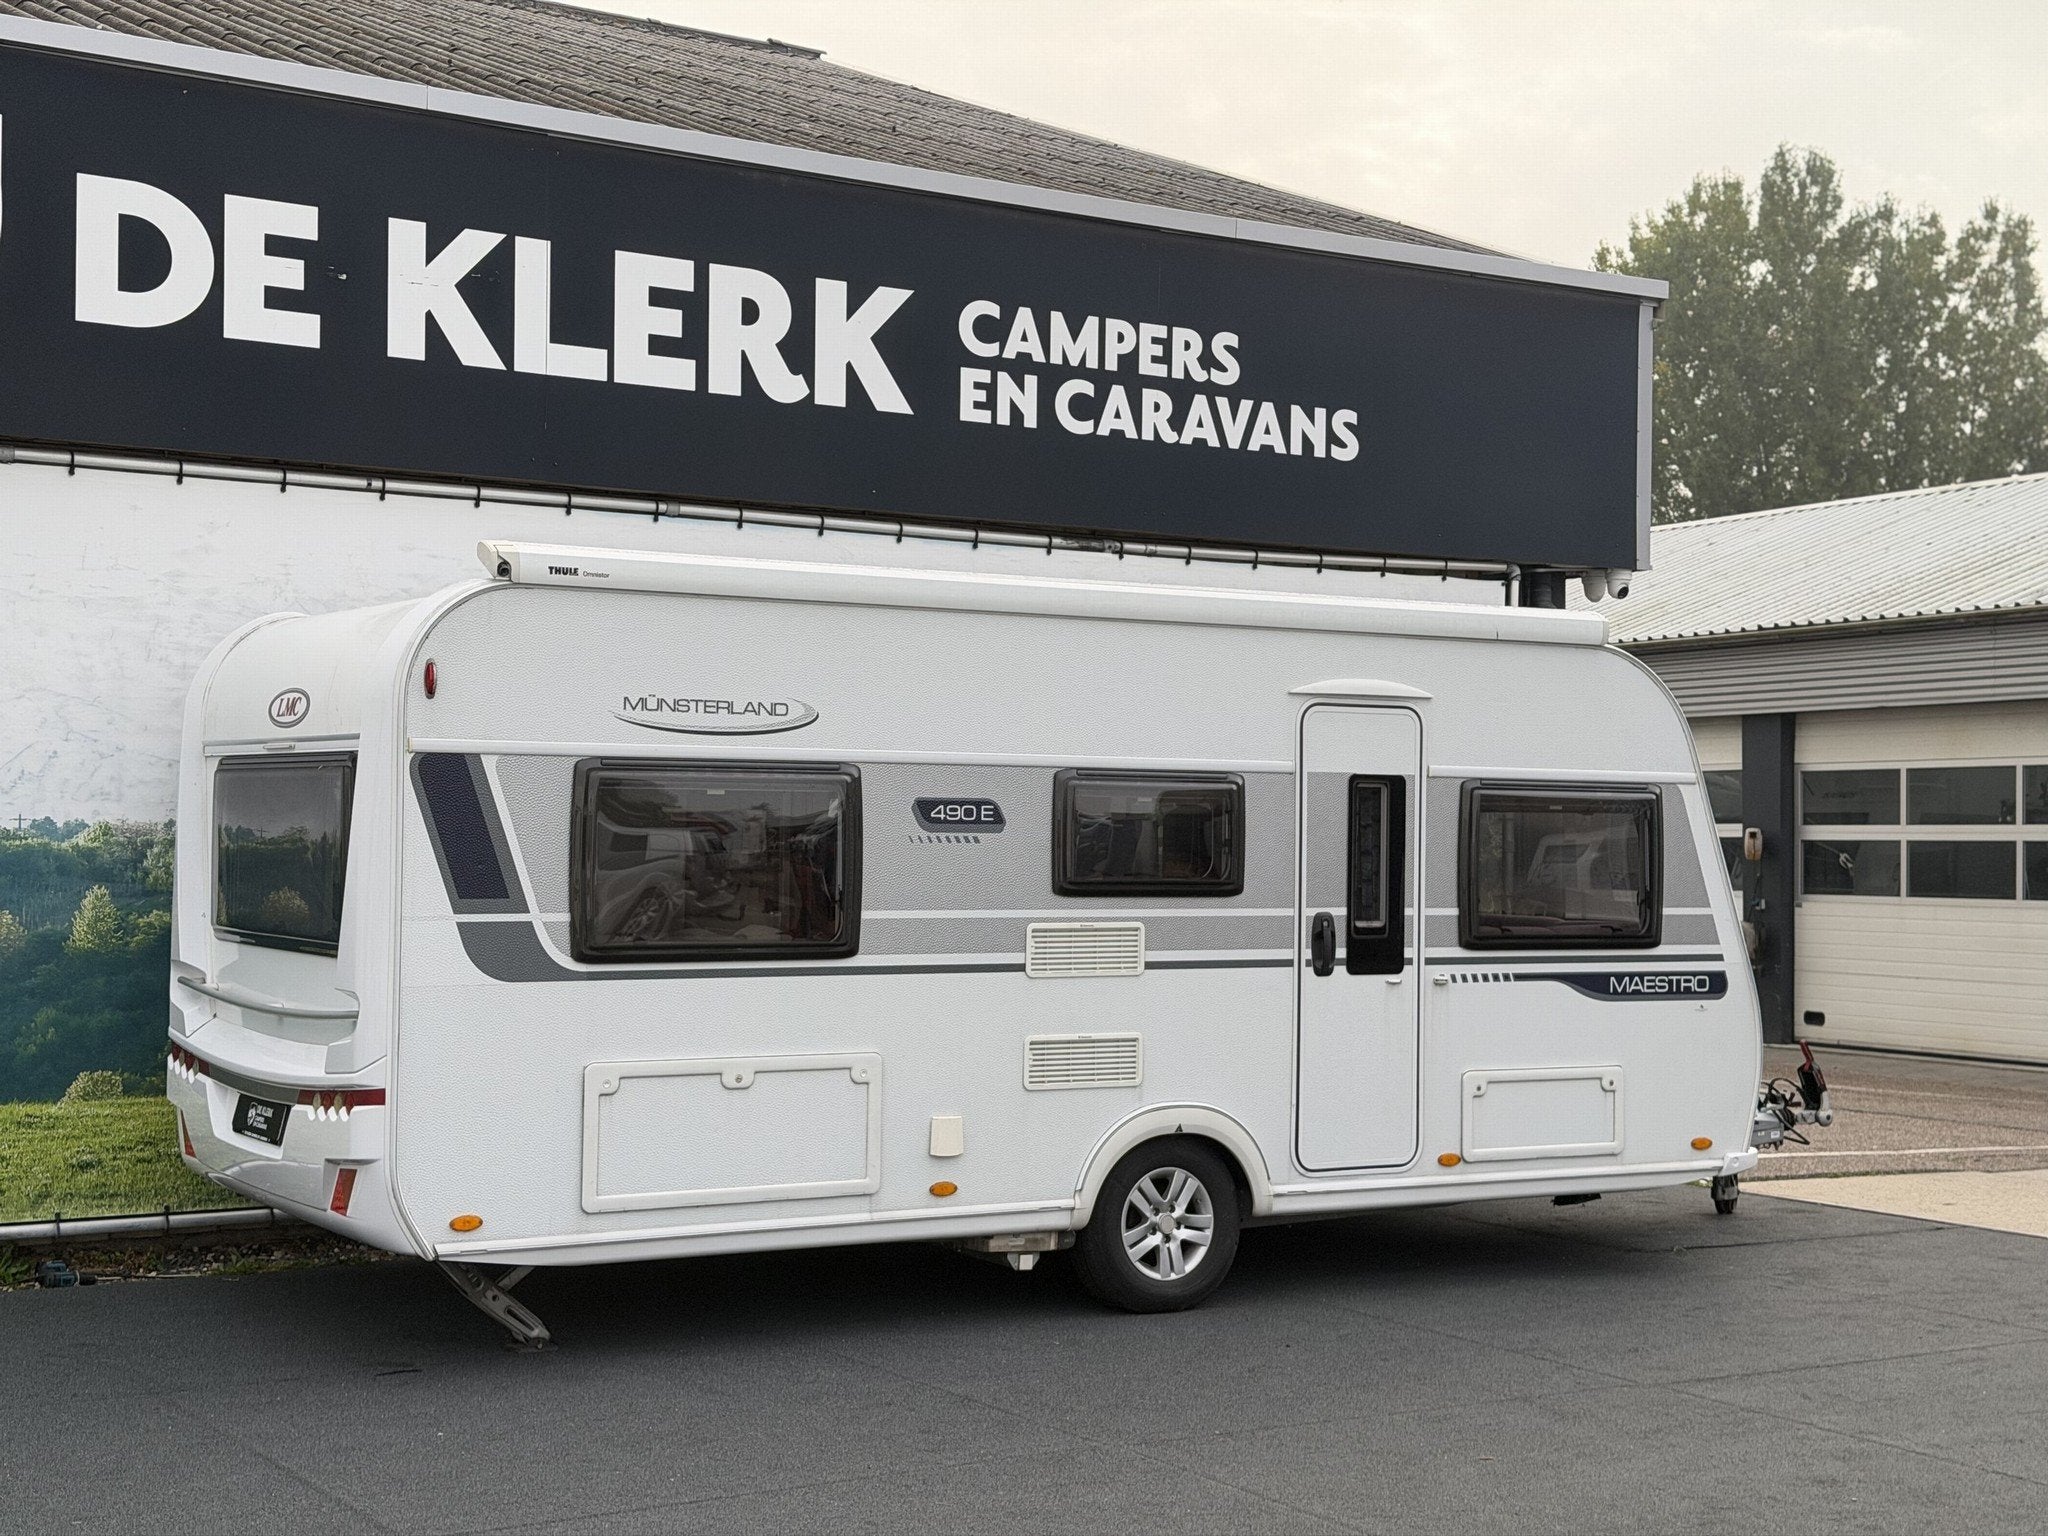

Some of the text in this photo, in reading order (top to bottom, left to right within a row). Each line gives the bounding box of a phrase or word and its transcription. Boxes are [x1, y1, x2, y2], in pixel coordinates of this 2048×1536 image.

[75, 172, 915, 416] DE KLERK
[958, 300, 1241, 386] CAMPERS
[959, 367, 1360, 463] EN CARAVANS
[548, 566, 610, 579] THULE Omnistor
[276, 696, 303, 718] LMC
[622, 694, 789, 717] MÜNSTERLAND
[930, 804, 995, 820] 490 E
[1609, 975, 1710, 993] MAESTRO
